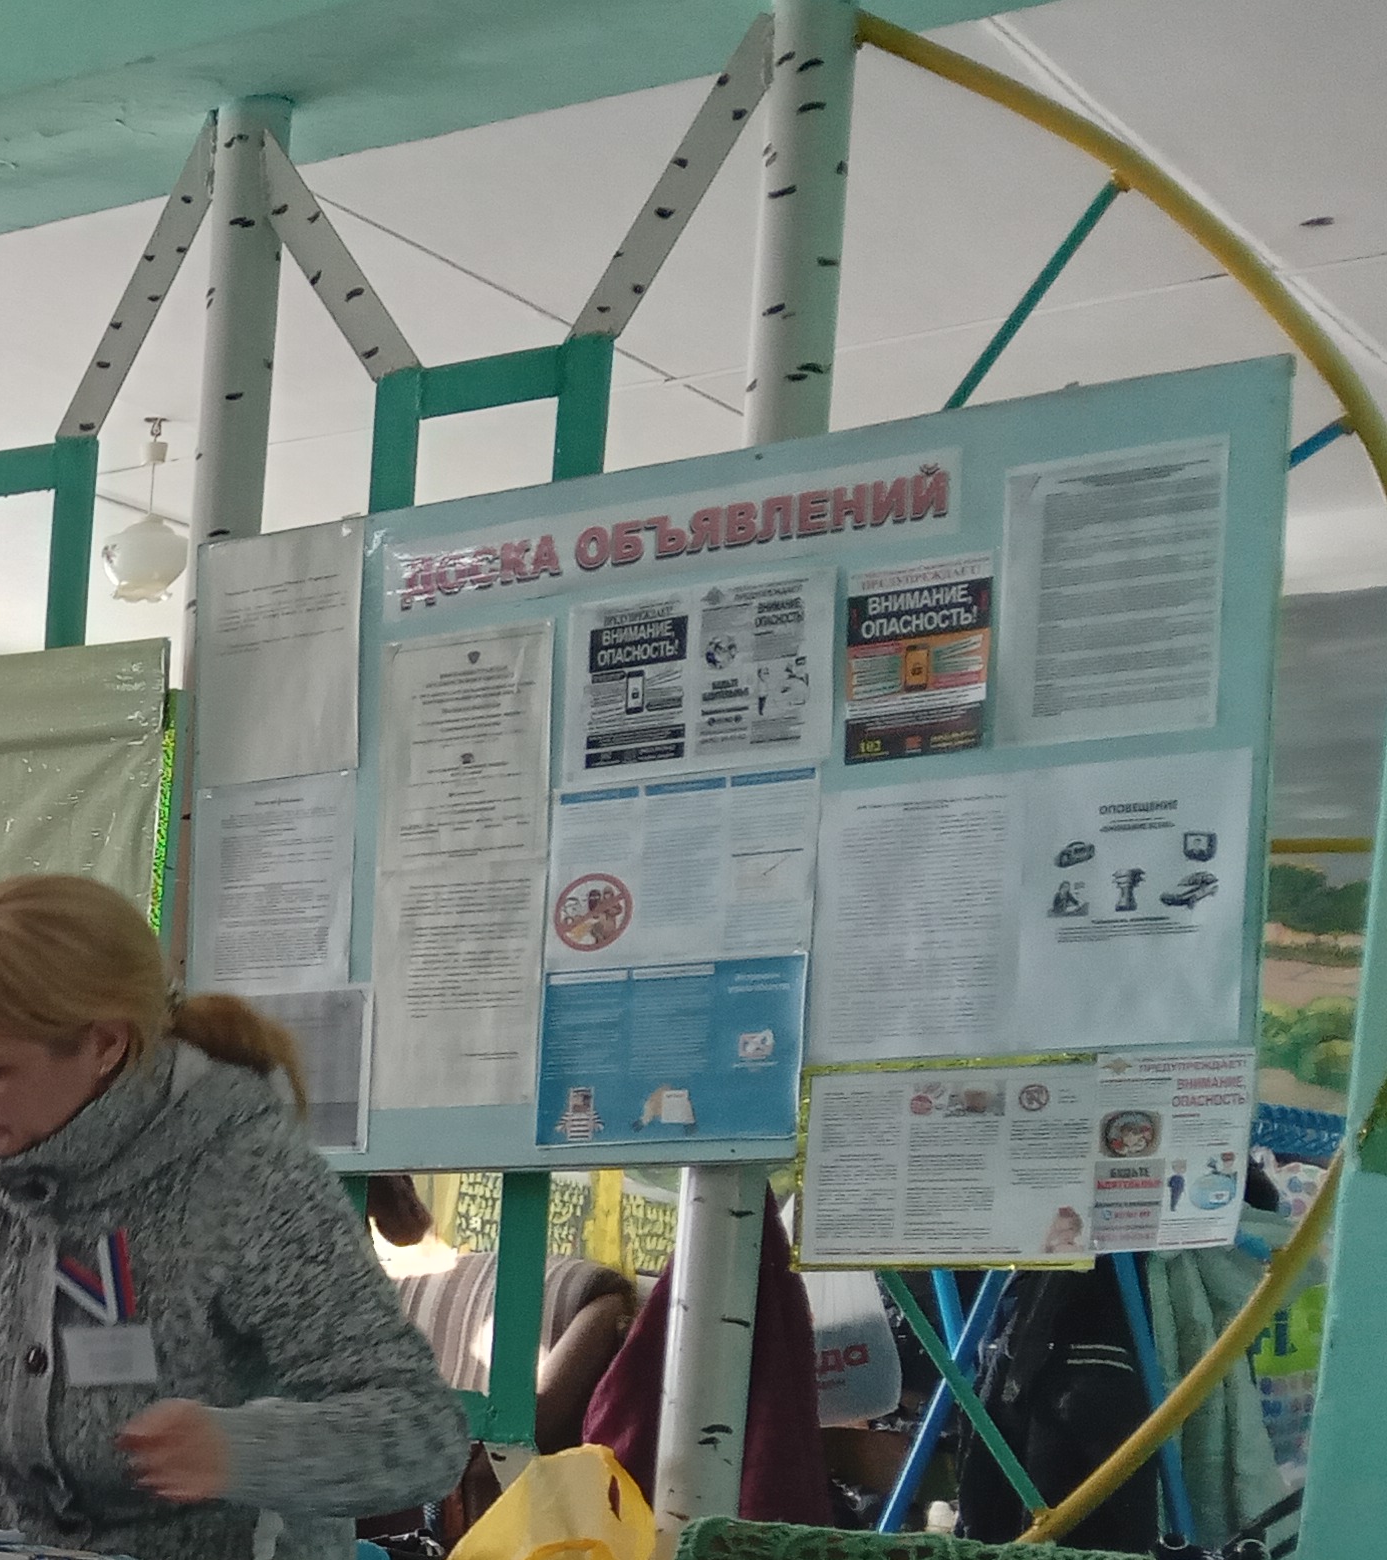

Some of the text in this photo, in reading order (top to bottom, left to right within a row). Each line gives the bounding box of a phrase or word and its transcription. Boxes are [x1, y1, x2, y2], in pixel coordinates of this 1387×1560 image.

[400, 463, 952, 612] ДОСКА ОБЪЯВЛЕНИЙ
[867, 584, 974, 616] ВНИМАНИЕ,
[602, 620, 675, 646] ВНИМАНИЕ,
[861, 606, 977, 640] ОПАСНОСТЬ!
[597, 639, 679, 667] ОПАСНОСТЬ!
